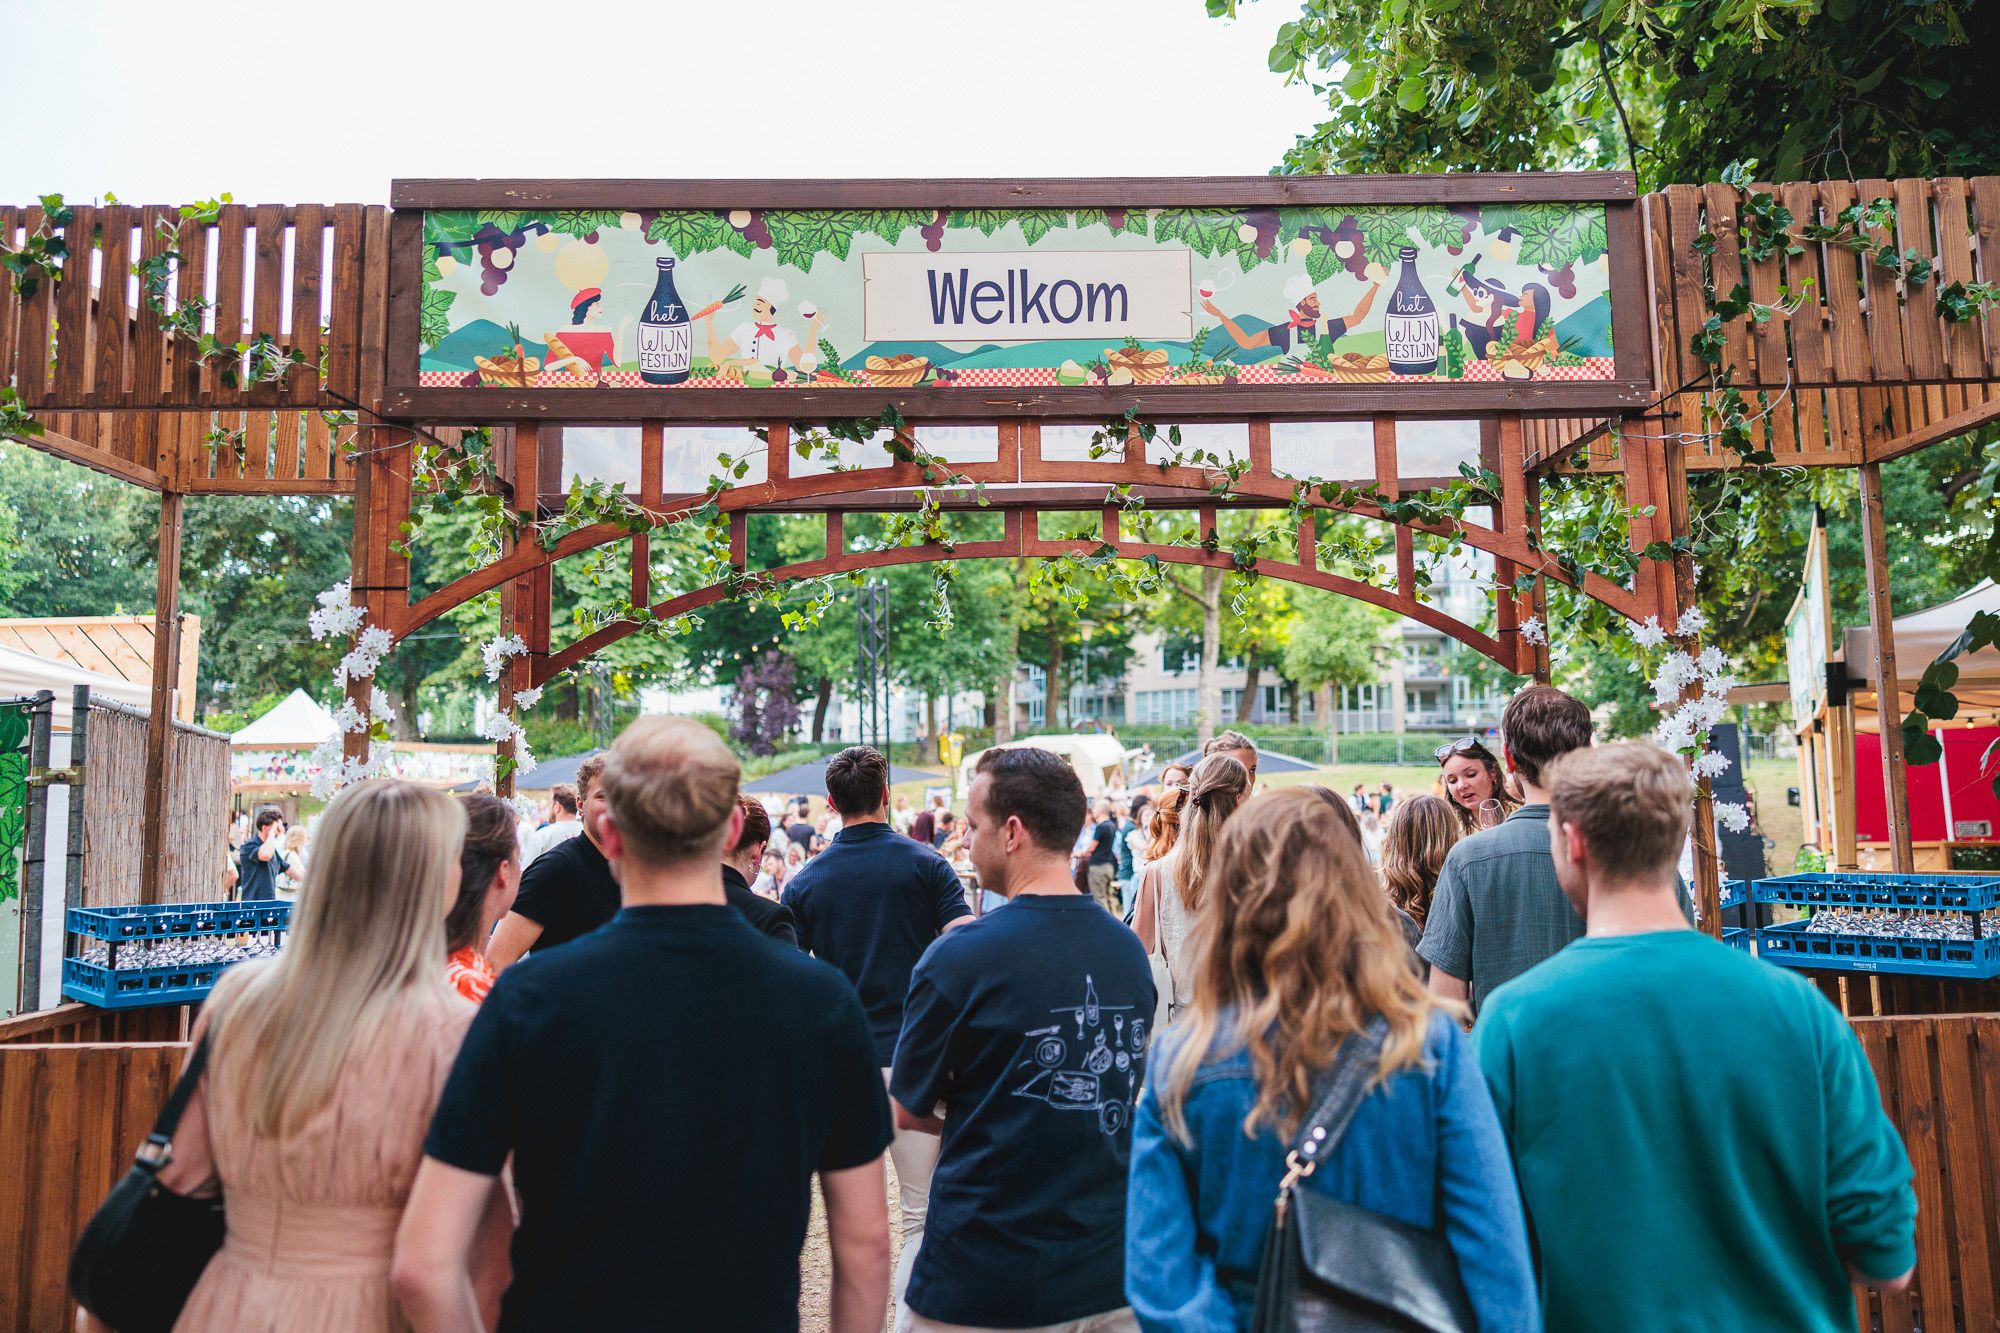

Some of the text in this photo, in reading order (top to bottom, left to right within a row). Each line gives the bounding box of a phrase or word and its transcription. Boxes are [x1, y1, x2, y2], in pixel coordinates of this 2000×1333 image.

[927, 268, 1128, 325] Welkom
[1397, 290, 1428, 312] het
[650, 300, 683, 322] het
[640, 328, 688, 352] WIJN
[1388, 318, 1435, 343] WIJN
[640, 352, 688, 368] FESTIJN
[1388, 342, 1435, 359] FESTIJN
